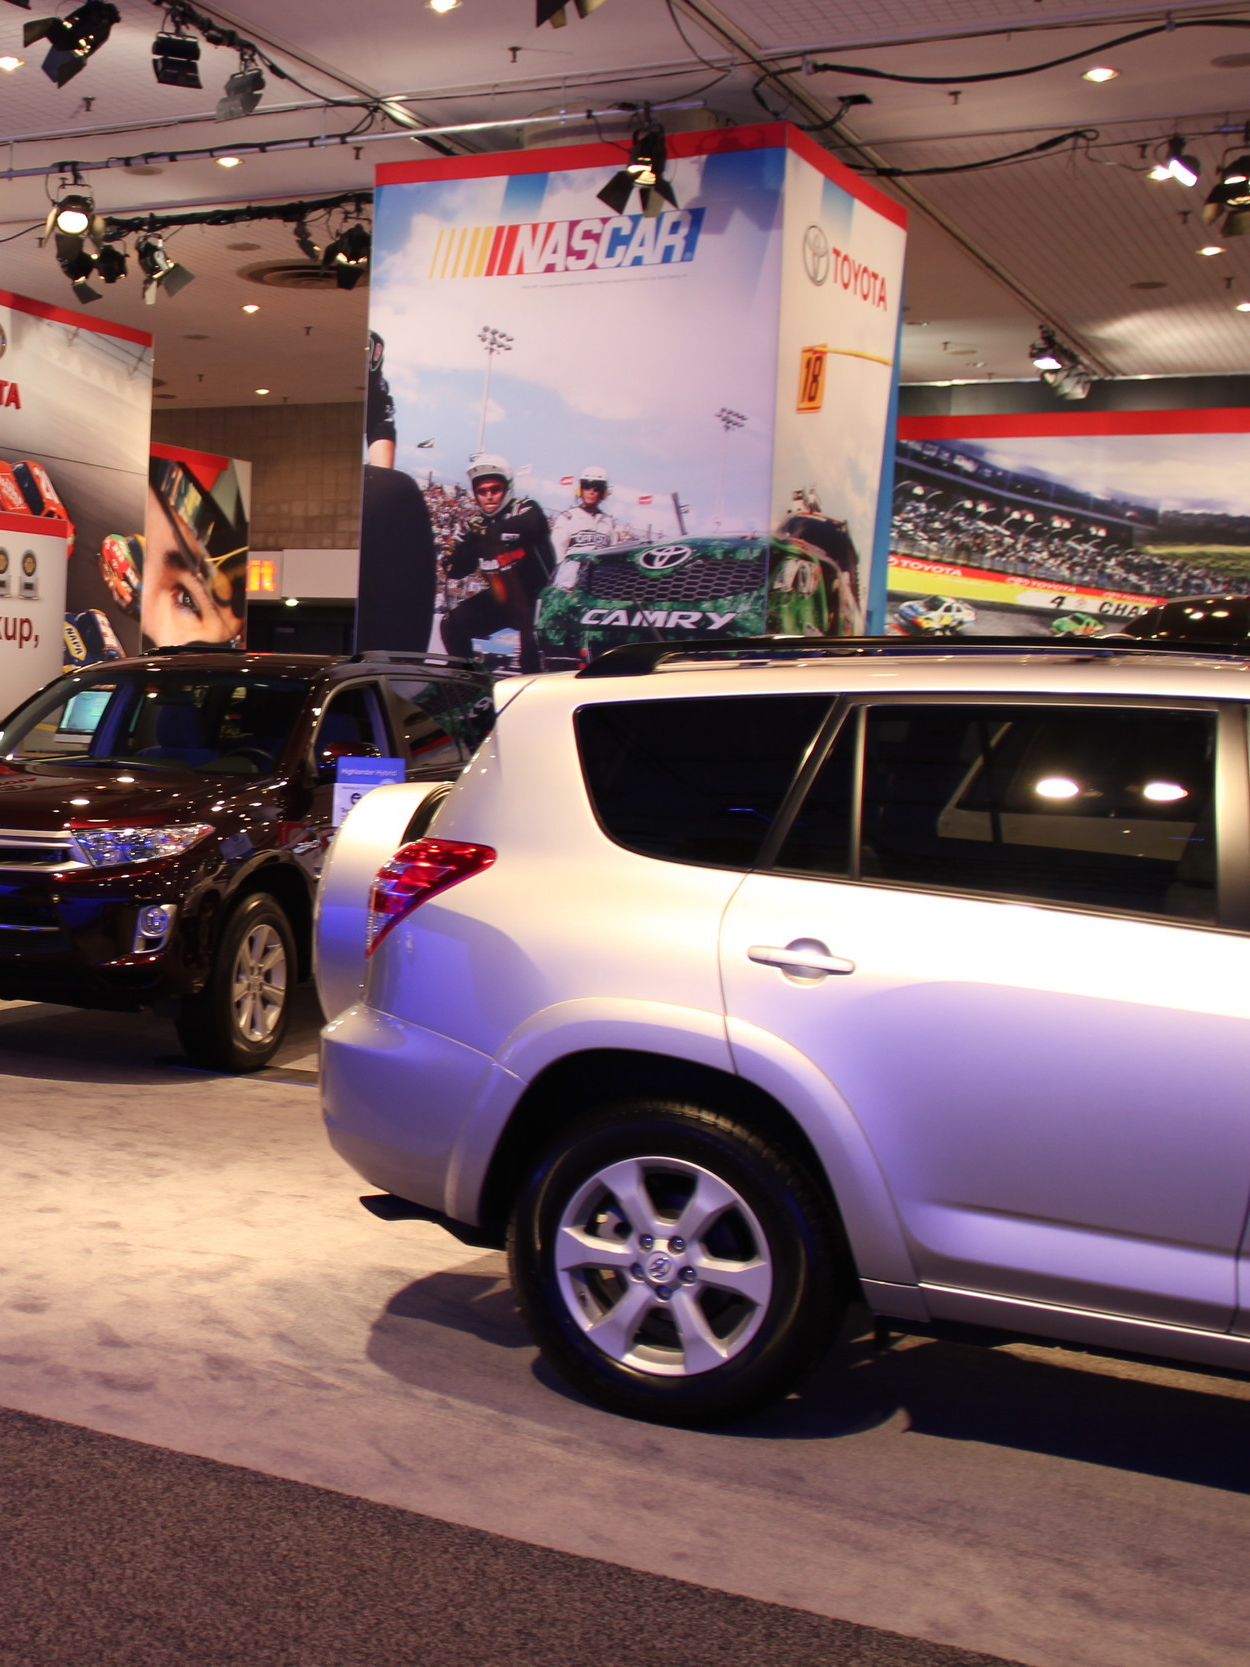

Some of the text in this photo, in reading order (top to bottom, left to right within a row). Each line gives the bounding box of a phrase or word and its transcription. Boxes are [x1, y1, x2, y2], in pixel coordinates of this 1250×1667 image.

[508, 209, 693, 275] NASCAR
[832, 246, 888, 312] TOYOTA
[800, 355, 823, 404] 18
[245, 559, 277, 592] it
[899, 559, 963, 577] TOYOTA
[1028, 580, 1077, 593] TOYOTA
[1050, 595, 1068, 609] 4
[580, 608, 739, 631] CAMRY
[65, 626, 83, 656] NAPA
